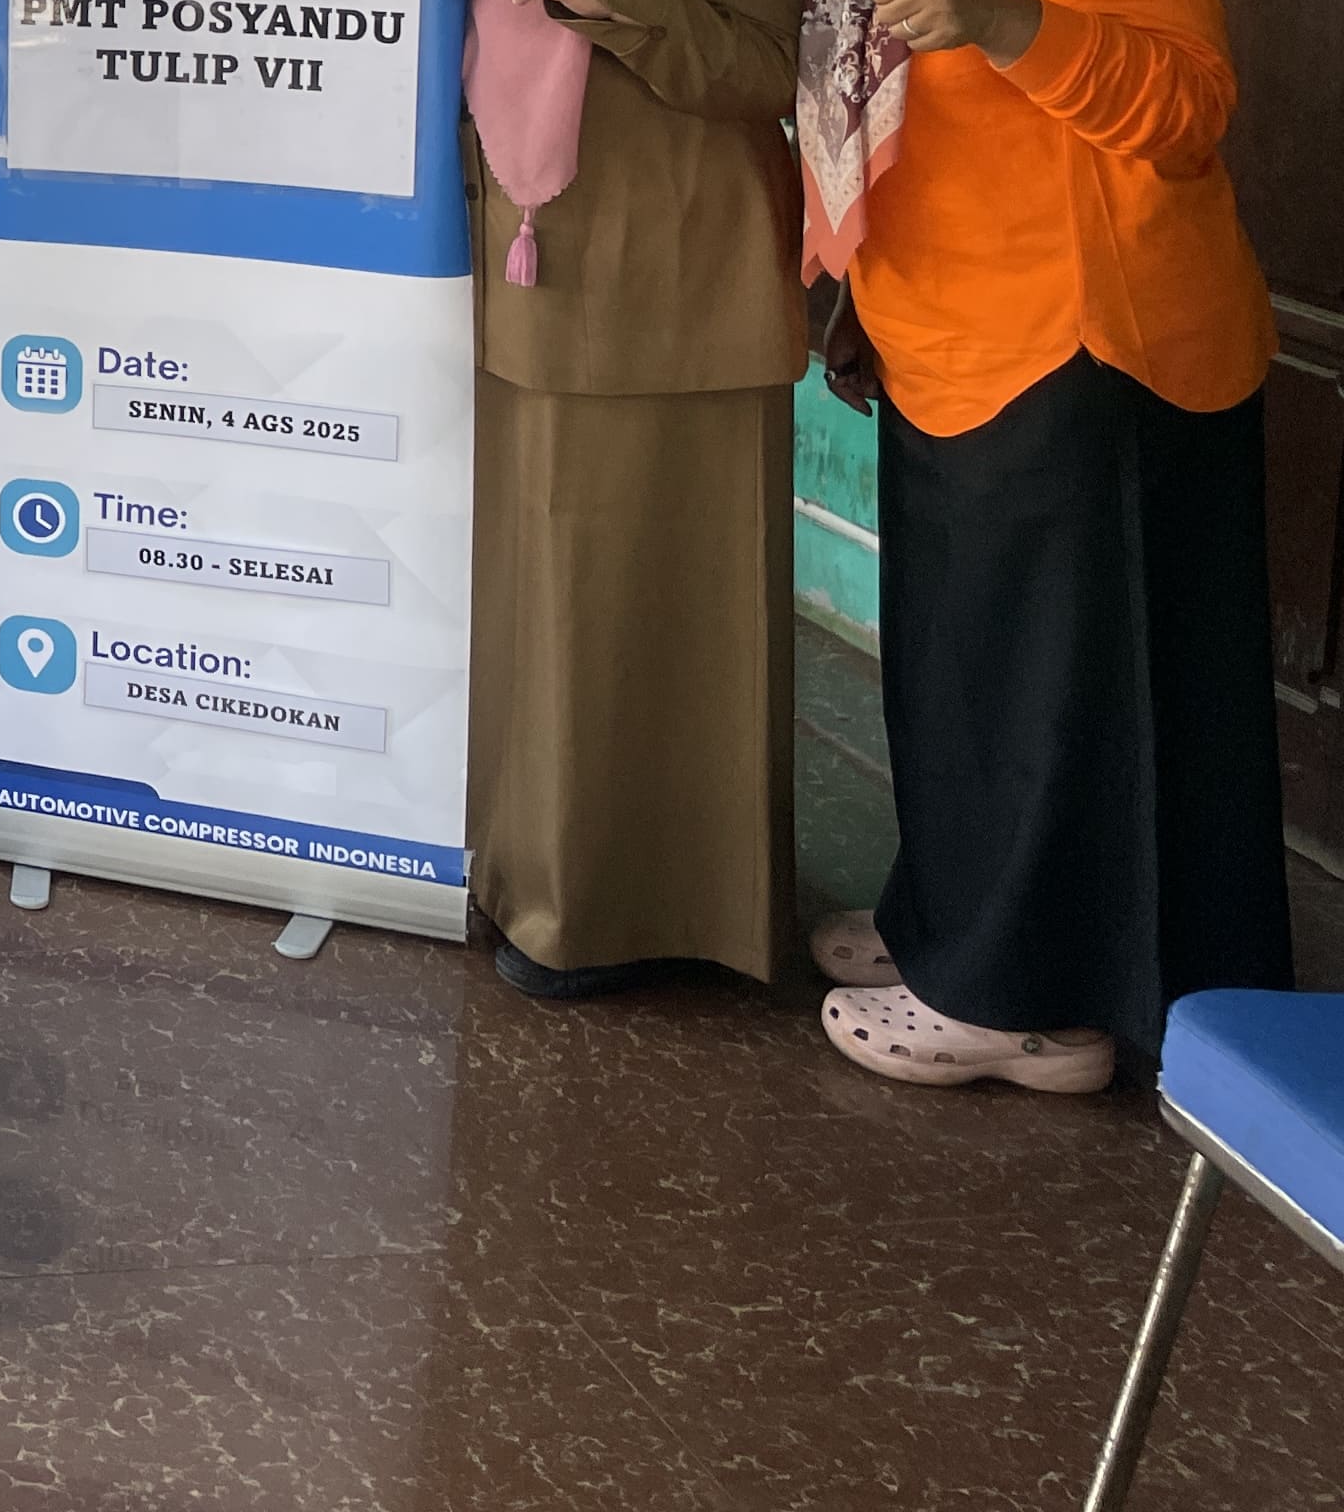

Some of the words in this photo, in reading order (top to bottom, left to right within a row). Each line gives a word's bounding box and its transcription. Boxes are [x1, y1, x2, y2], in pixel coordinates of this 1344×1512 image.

[96, 48, 238, 86] TULIP
[255, 57, 323, 92] VII
[98, 347, 189, 382] Date:
[128, 399, 212, 429] SENIN,
[221, 410, 235, 428] 4
[243, 411, 294, 435] AGS
[303, 418, 360, 443] 2025
[93, 492, 188, 529] Time:
[138, 548, 204, 571] 08.30
[228, 557, 334, 586] SELESAI
[91, 631, 252, 679] Location:
[127, 682, 188, 707] DESA
[195, 692, 341, 732] CIKEDOKAN
[143, 812, 299, 855] COMPRESSOR
[308, 841, 436, 879] INDONESIA
